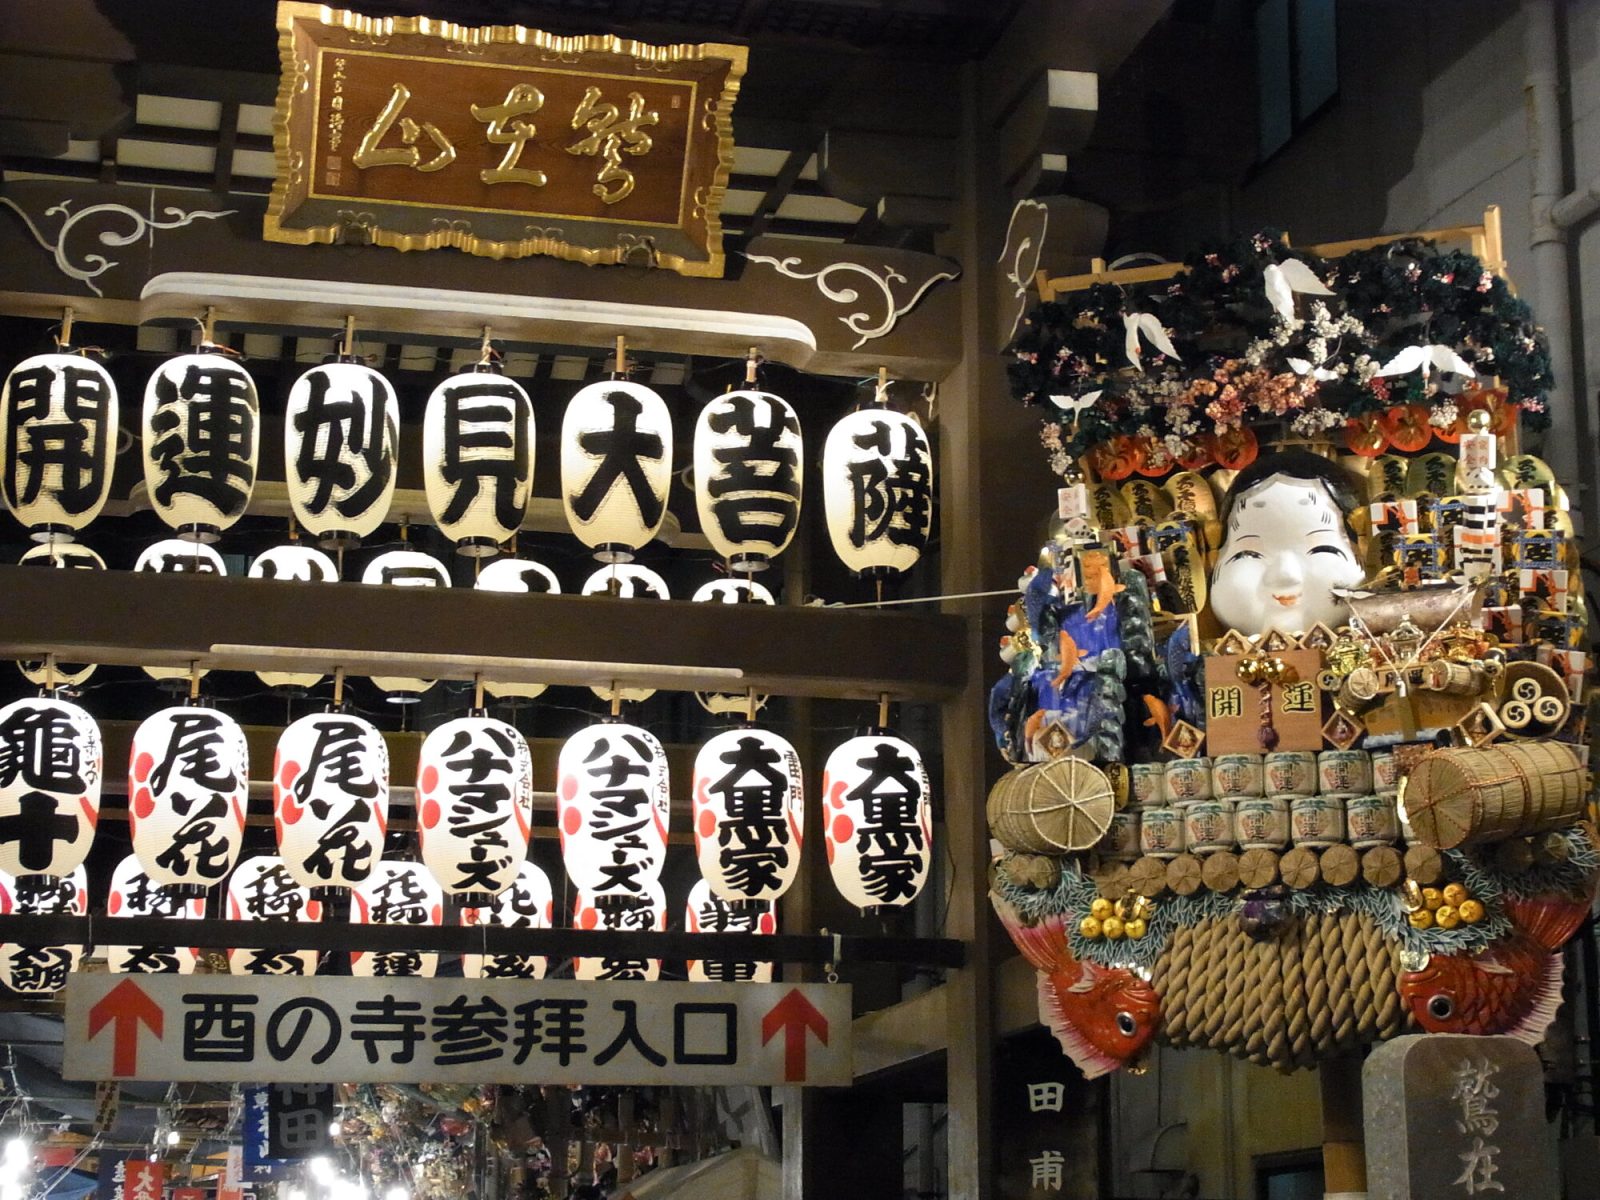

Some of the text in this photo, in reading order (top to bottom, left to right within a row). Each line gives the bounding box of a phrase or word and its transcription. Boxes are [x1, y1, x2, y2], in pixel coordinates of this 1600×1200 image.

[5, 365, 111, 514] 開
[151, 364, 254, 517] 運
[294, 370, 398, 518] 妙
[440, 383, 531, 530] 見
[570, 391, 665, 527] 大
[707, 395, 800, 547] 菩
[848, 420, 932, 550] 薩
[150, 714, 237, 878] 尾花
[294, 721, 379, 881] 尾花
[708, 736, 789, 896] 大黒家
[846, 743, 923, 902] 大黒家
[182, 992, 738, 1068] 酉の寺参拝入口
